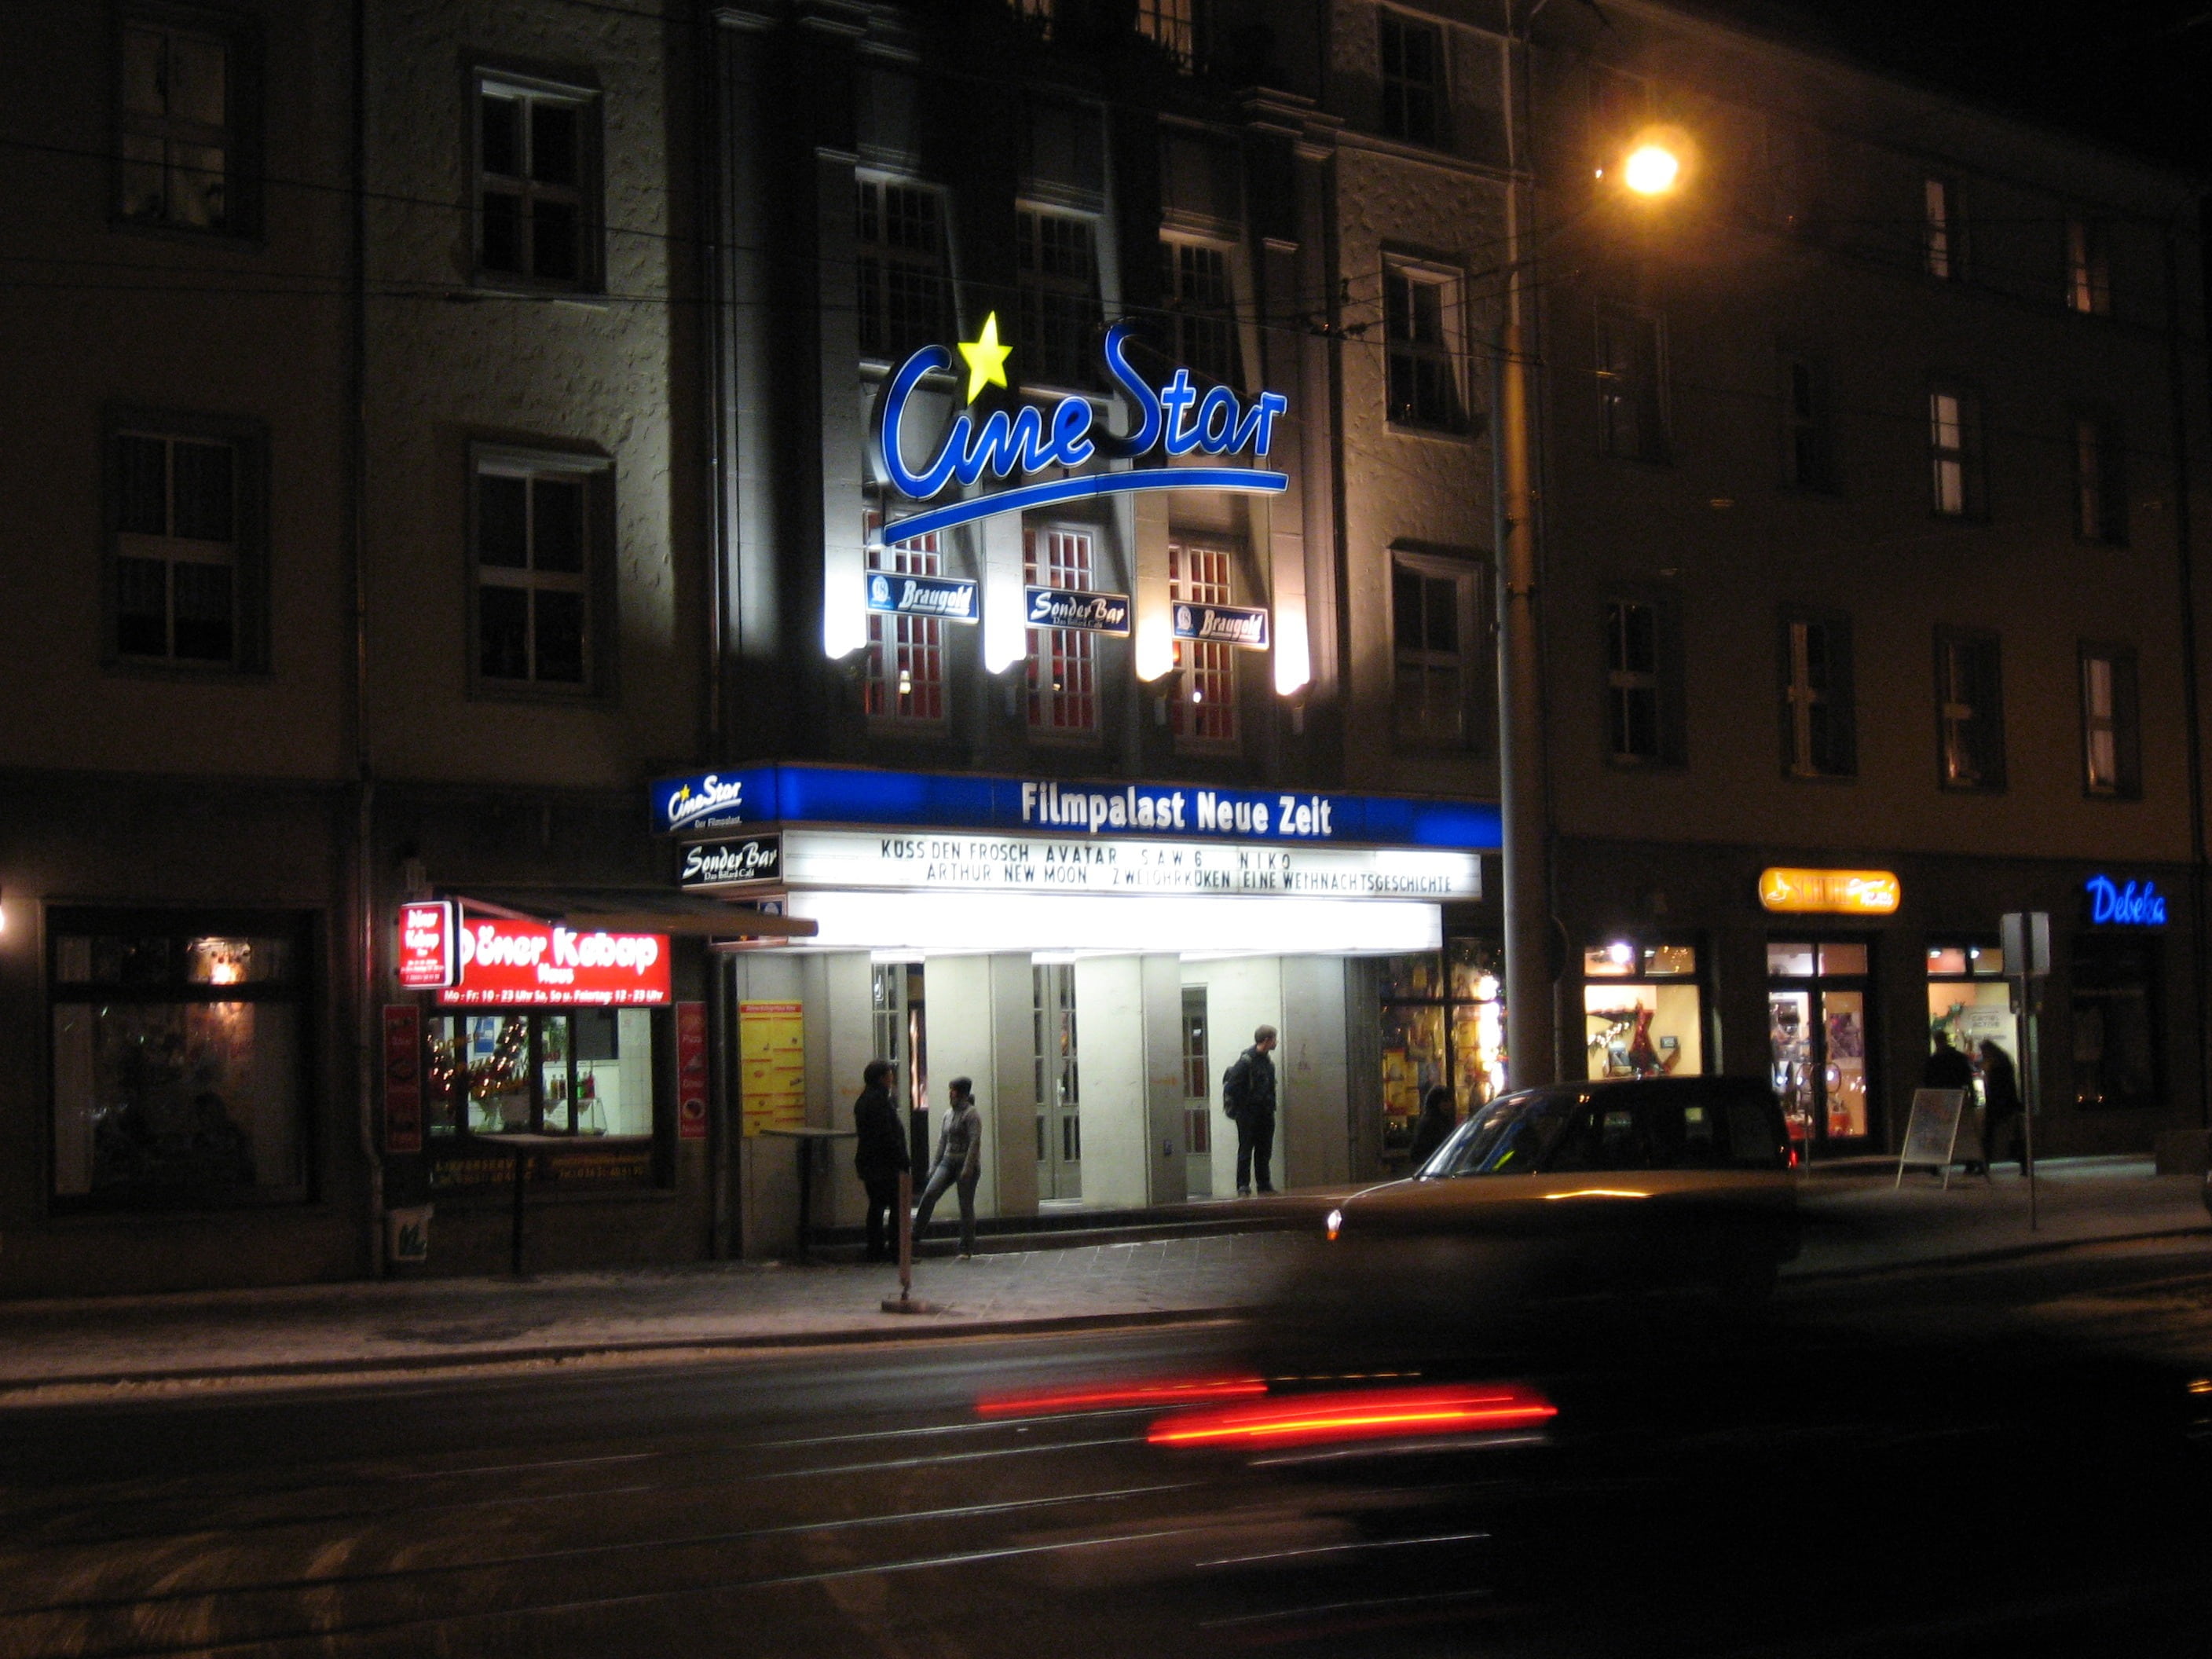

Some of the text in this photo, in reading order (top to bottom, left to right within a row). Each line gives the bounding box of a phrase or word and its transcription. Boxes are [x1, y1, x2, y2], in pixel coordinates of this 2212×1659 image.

[898, 580, 973, 615] Braugold
[1031, 591, 1124, 624] Sonder Bar
[1199, 609, 1263, 643] Braugold
[1022, 782, 1333, 836] Filmpalast Neue Zeit
[682, 842, 777, 879] Sonder Bar
[932, 840, 961, 860] DEN
[970, 841, 1029, 862] FROSCH
[1046, 845, 1117, 865] AVATAR
[1141, 848, 1183, 866] SAW
[1194, 851, 1202, 866] 6
[1240, 852, 1291, 870] NIKO
[926, 862, 991, 881] ARTHUR
[1004, 864, 1035, 883] NEW
[1044, 866, 1087, 884] MOON
[1243, 870, 1276, 889] EINE
[2086, 876, 2166, 925] Debeka
[553, 927, 658, 976] Kebap
[444, 990, 460, 1002] Mo
[482, 990, 495, 1002] 10
[501, 990, 515, 1002] 23
[515, 990, 533, 1002] Uhr
[550, 991, 562, 1003] So
[615, 990, 627, 1002] 12
[632, 990, 646, 1002] 23
[646, 990, 664, 1002] Uhr
